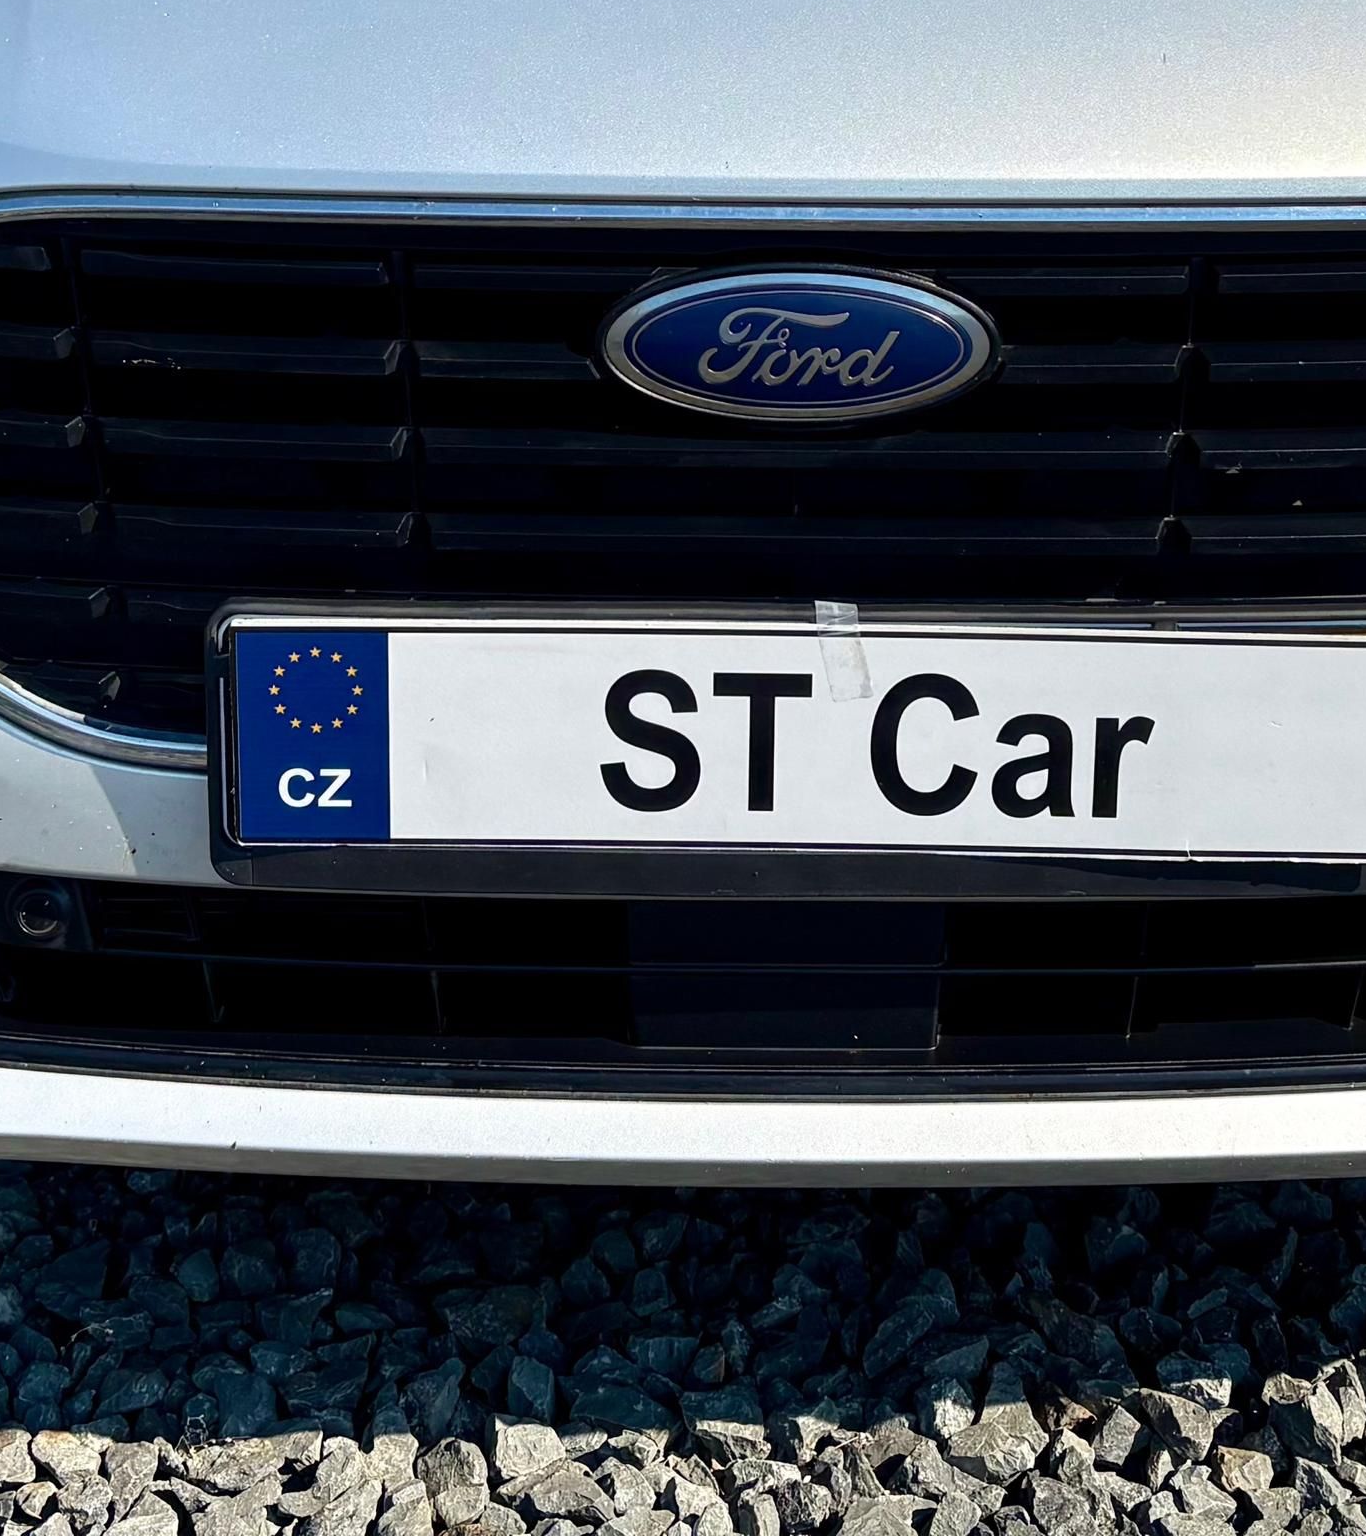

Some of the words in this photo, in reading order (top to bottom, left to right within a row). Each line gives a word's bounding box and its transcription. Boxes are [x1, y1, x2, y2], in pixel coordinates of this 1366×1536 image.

[698, 307, 900, 387] Ford
[600, 669, 813, 813] ST
[870, 673, 1156, 819] Car
[278, 767, 353, 808] CZ
